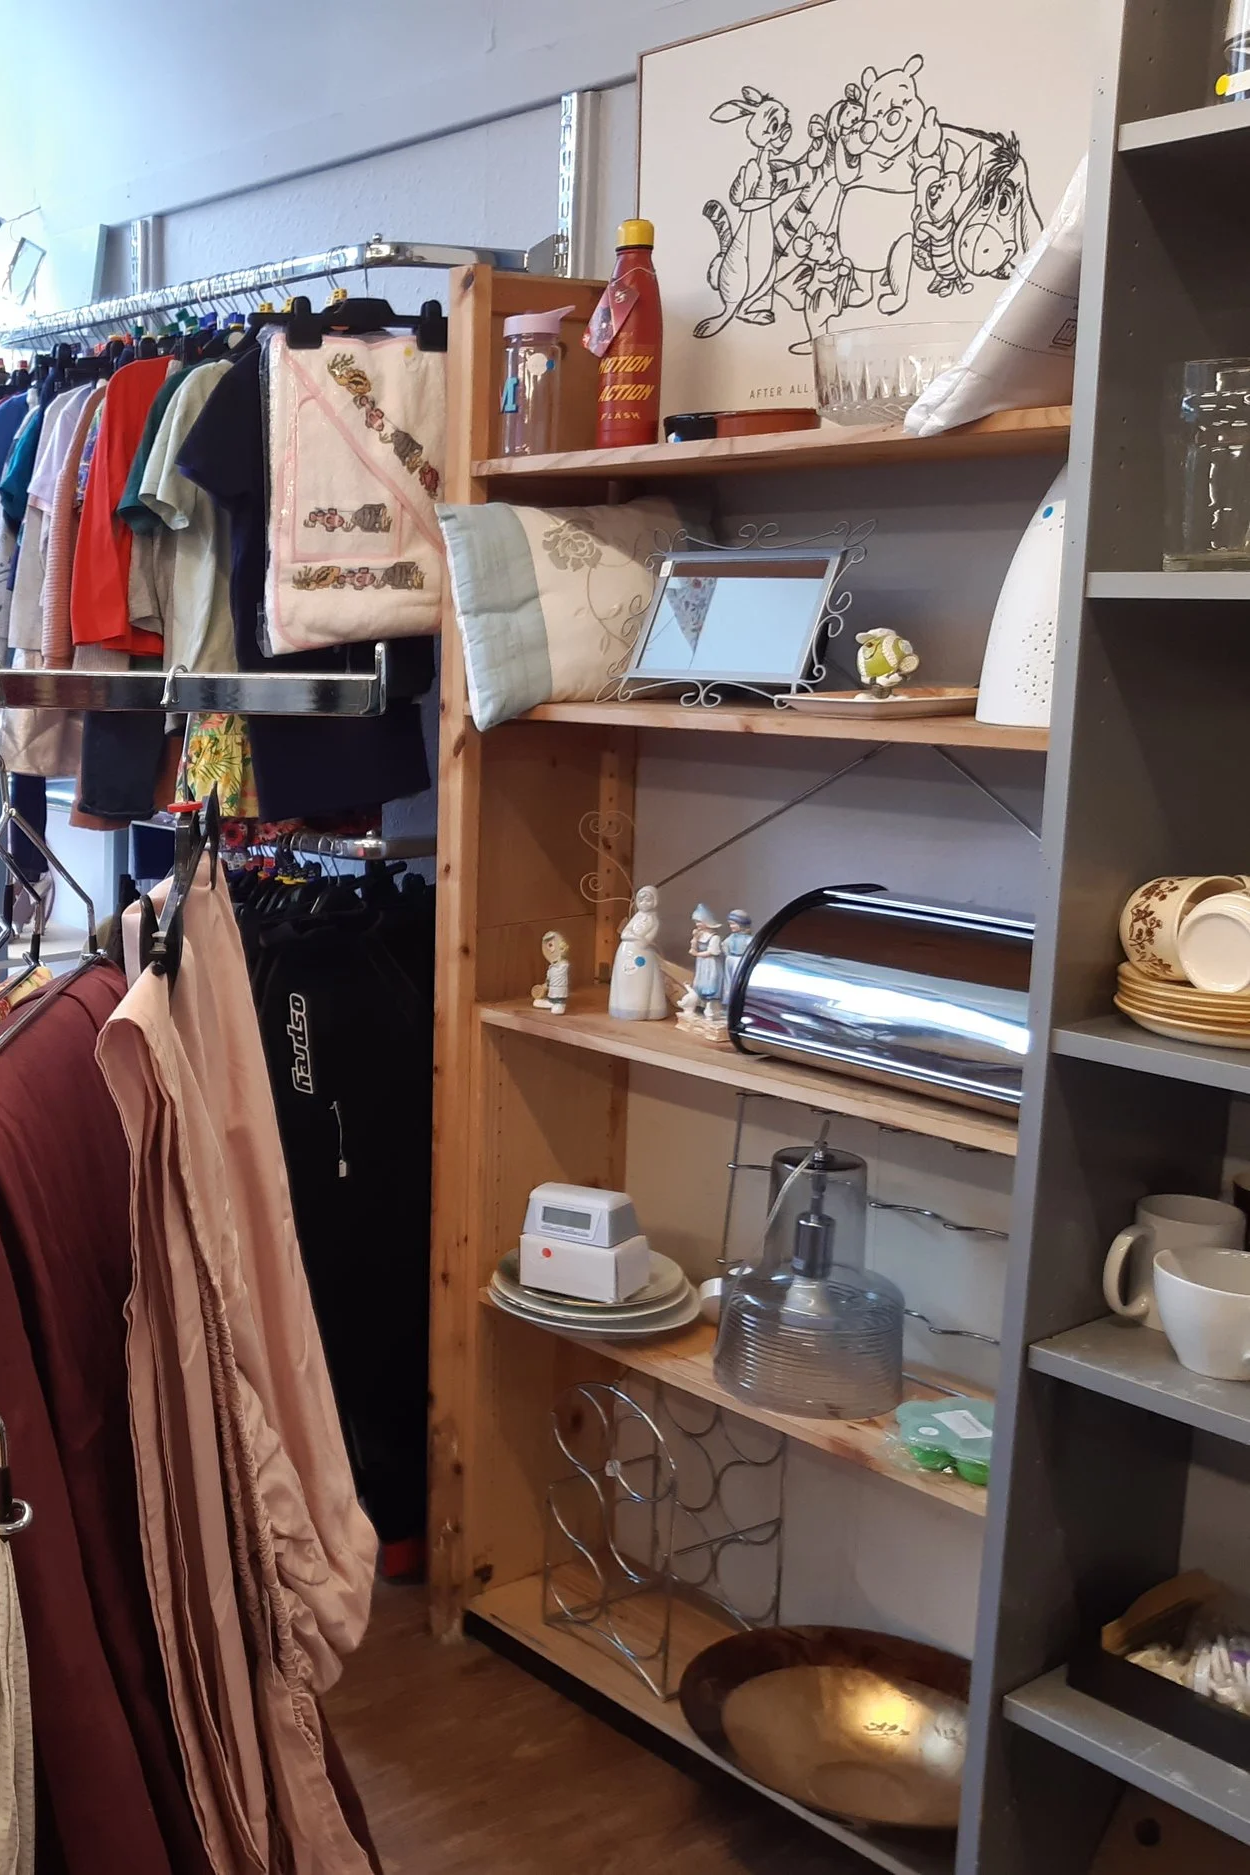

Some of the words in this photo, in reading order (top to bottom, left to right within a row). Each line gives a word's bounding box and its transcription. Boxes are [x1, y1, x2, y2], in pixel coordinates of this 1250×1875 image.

[598, 356, 654, 374] MOTION
[598, 384, 655, 402] ACTION
[750, 387, 782, 399] AFTER
